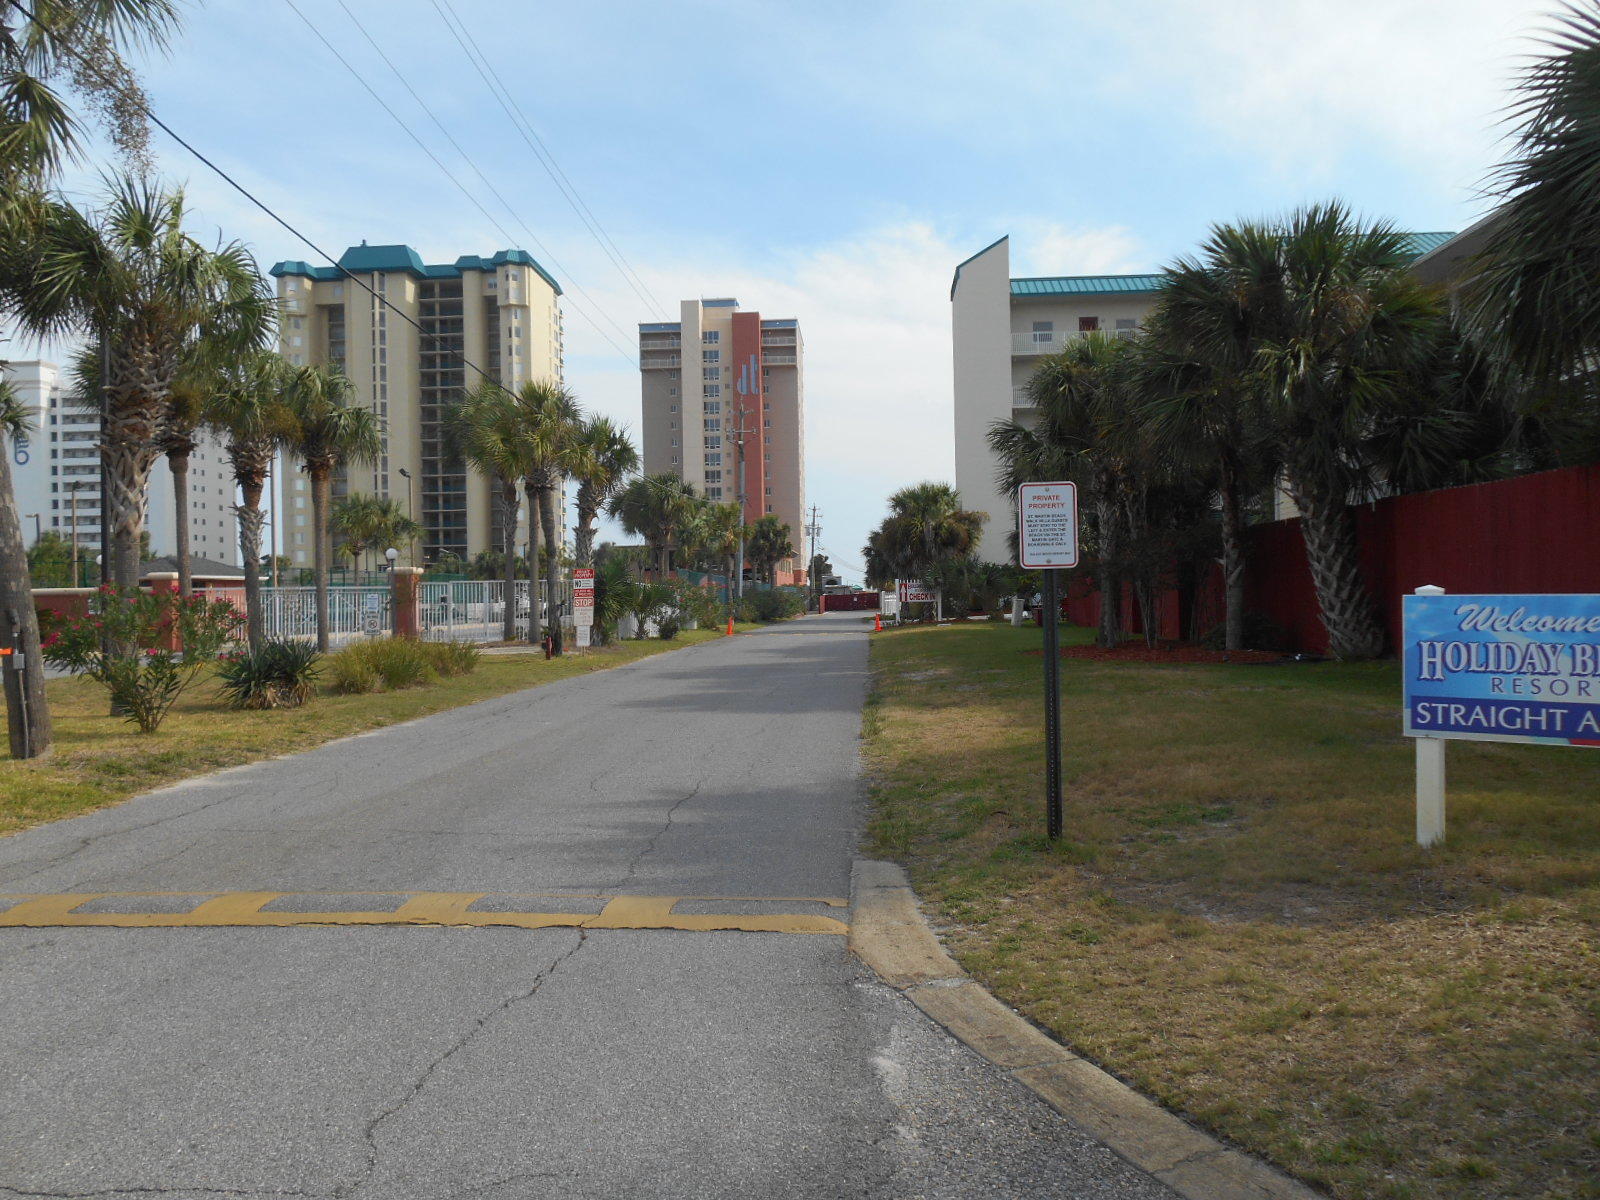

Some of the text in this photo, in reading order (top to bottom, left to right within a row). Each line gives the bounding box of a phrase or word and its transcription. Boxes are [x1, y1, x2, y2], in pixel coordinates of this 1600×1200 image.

[1454, 603, 1600, 633] Welcome
[1417, 640, 1565, 682] HOLIDAY
[1492, 677, 1600, 697] RESOR
[1416, 702, 1569, 732] STRAIGHT
